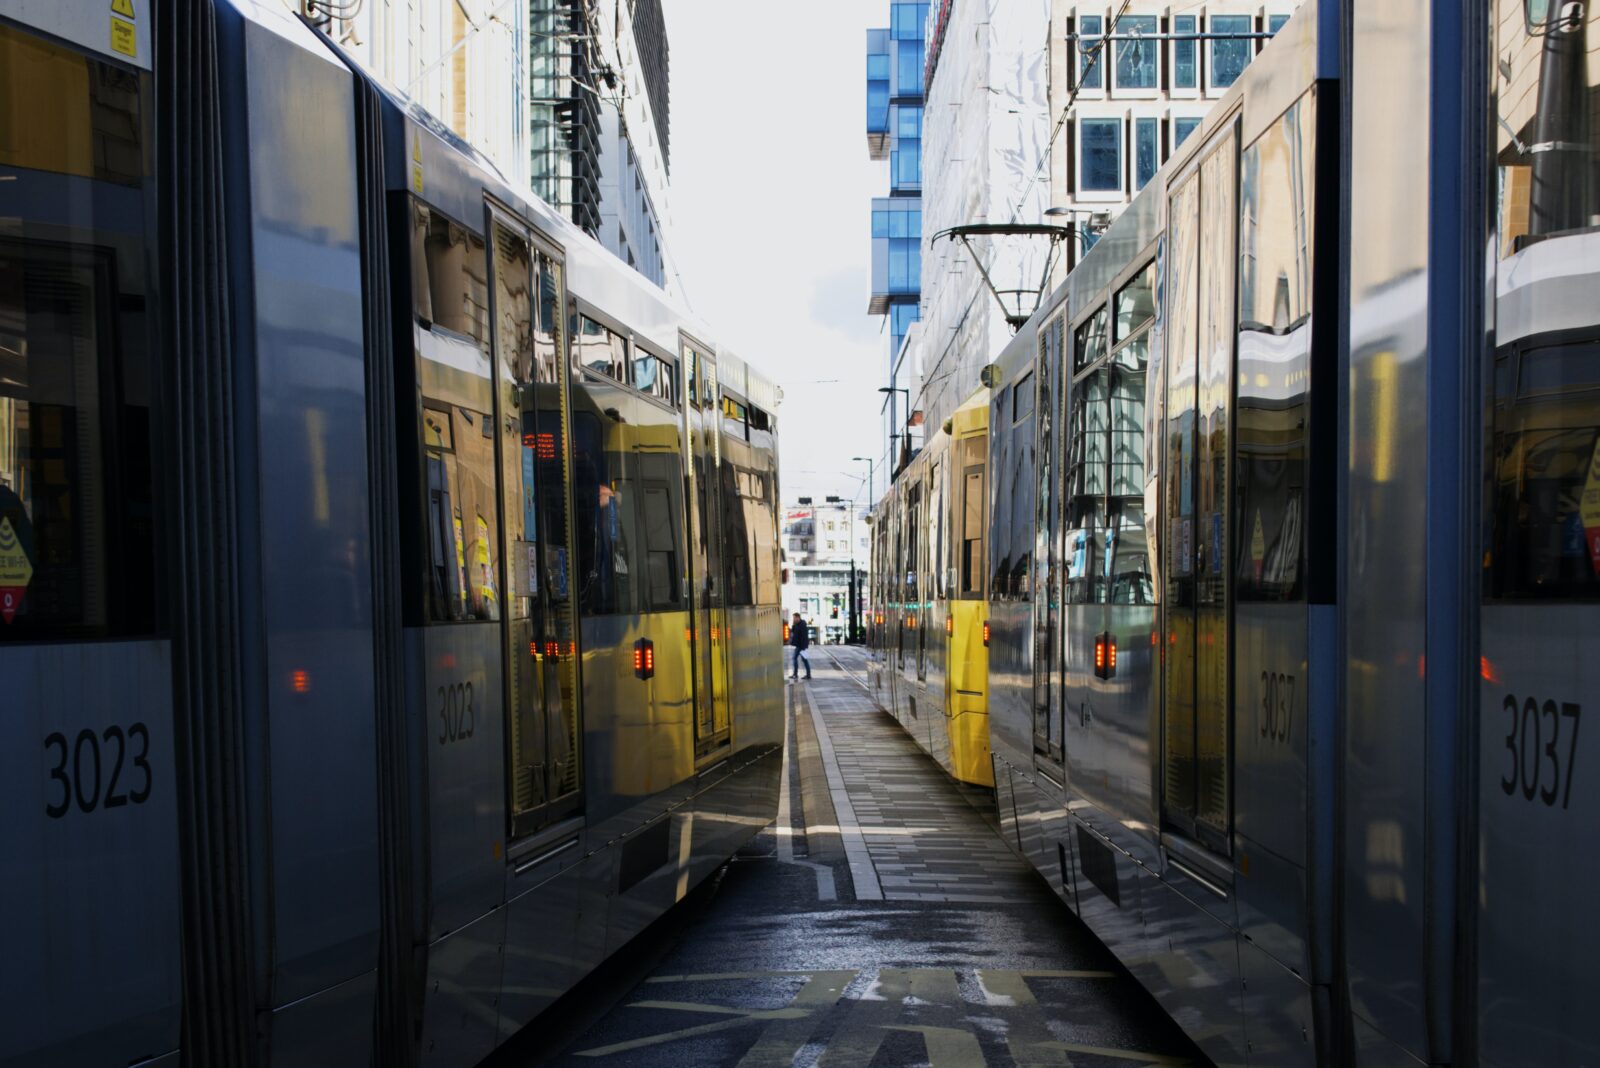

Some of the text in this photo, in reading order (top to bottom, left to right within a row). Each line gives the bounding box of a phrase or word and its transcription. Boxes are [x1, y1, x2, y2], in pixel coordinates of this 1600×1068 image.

[438, 681, 474, 745] 3023
[1261, 671, 1295, 744] 3037
[44, 722, 152, 819] 3023
[1502, 693, 1581, 810] 3037
